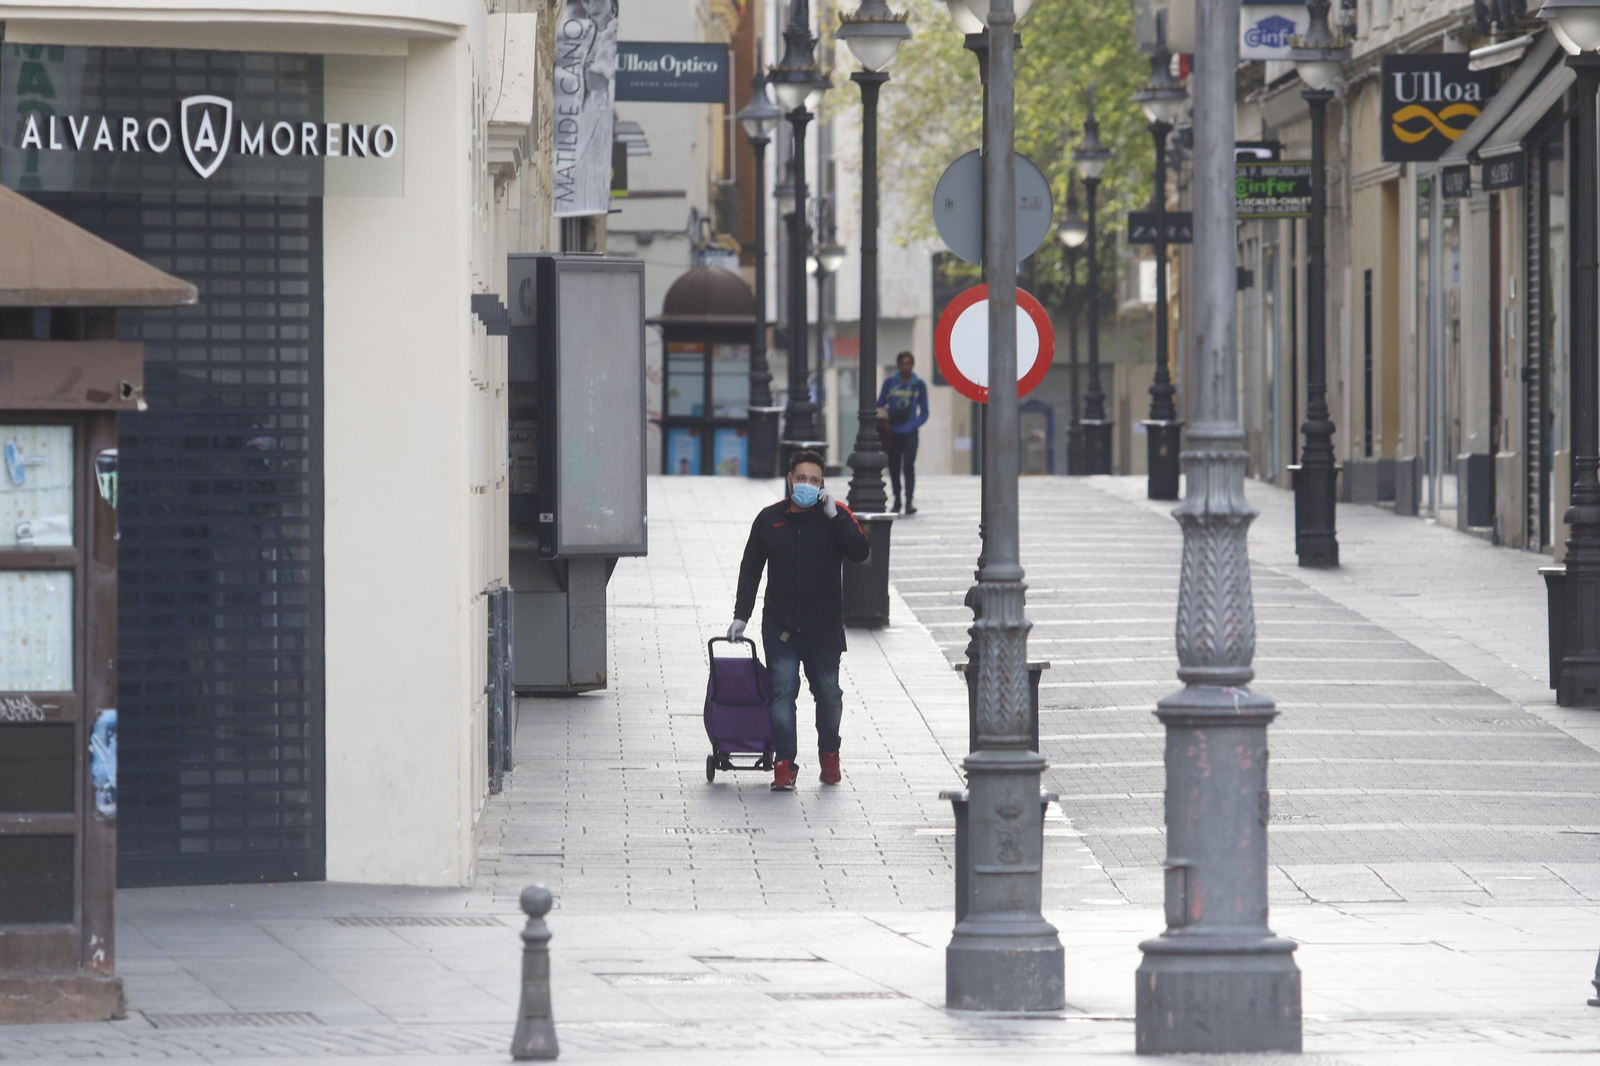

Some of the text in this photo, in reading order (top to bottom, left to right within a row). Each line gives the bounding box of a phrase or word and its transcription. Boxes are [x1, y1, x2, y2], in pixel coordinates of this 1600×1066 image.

[615, 53, 718, 77] Ulloa Optico
[1391, 71, 1481, 102] Ulloa
[555, 18, 583, 202] MATILDE CANO
[21, 115, 171, 153] ALVARO
[240, 120, 398, 158] MORENO
